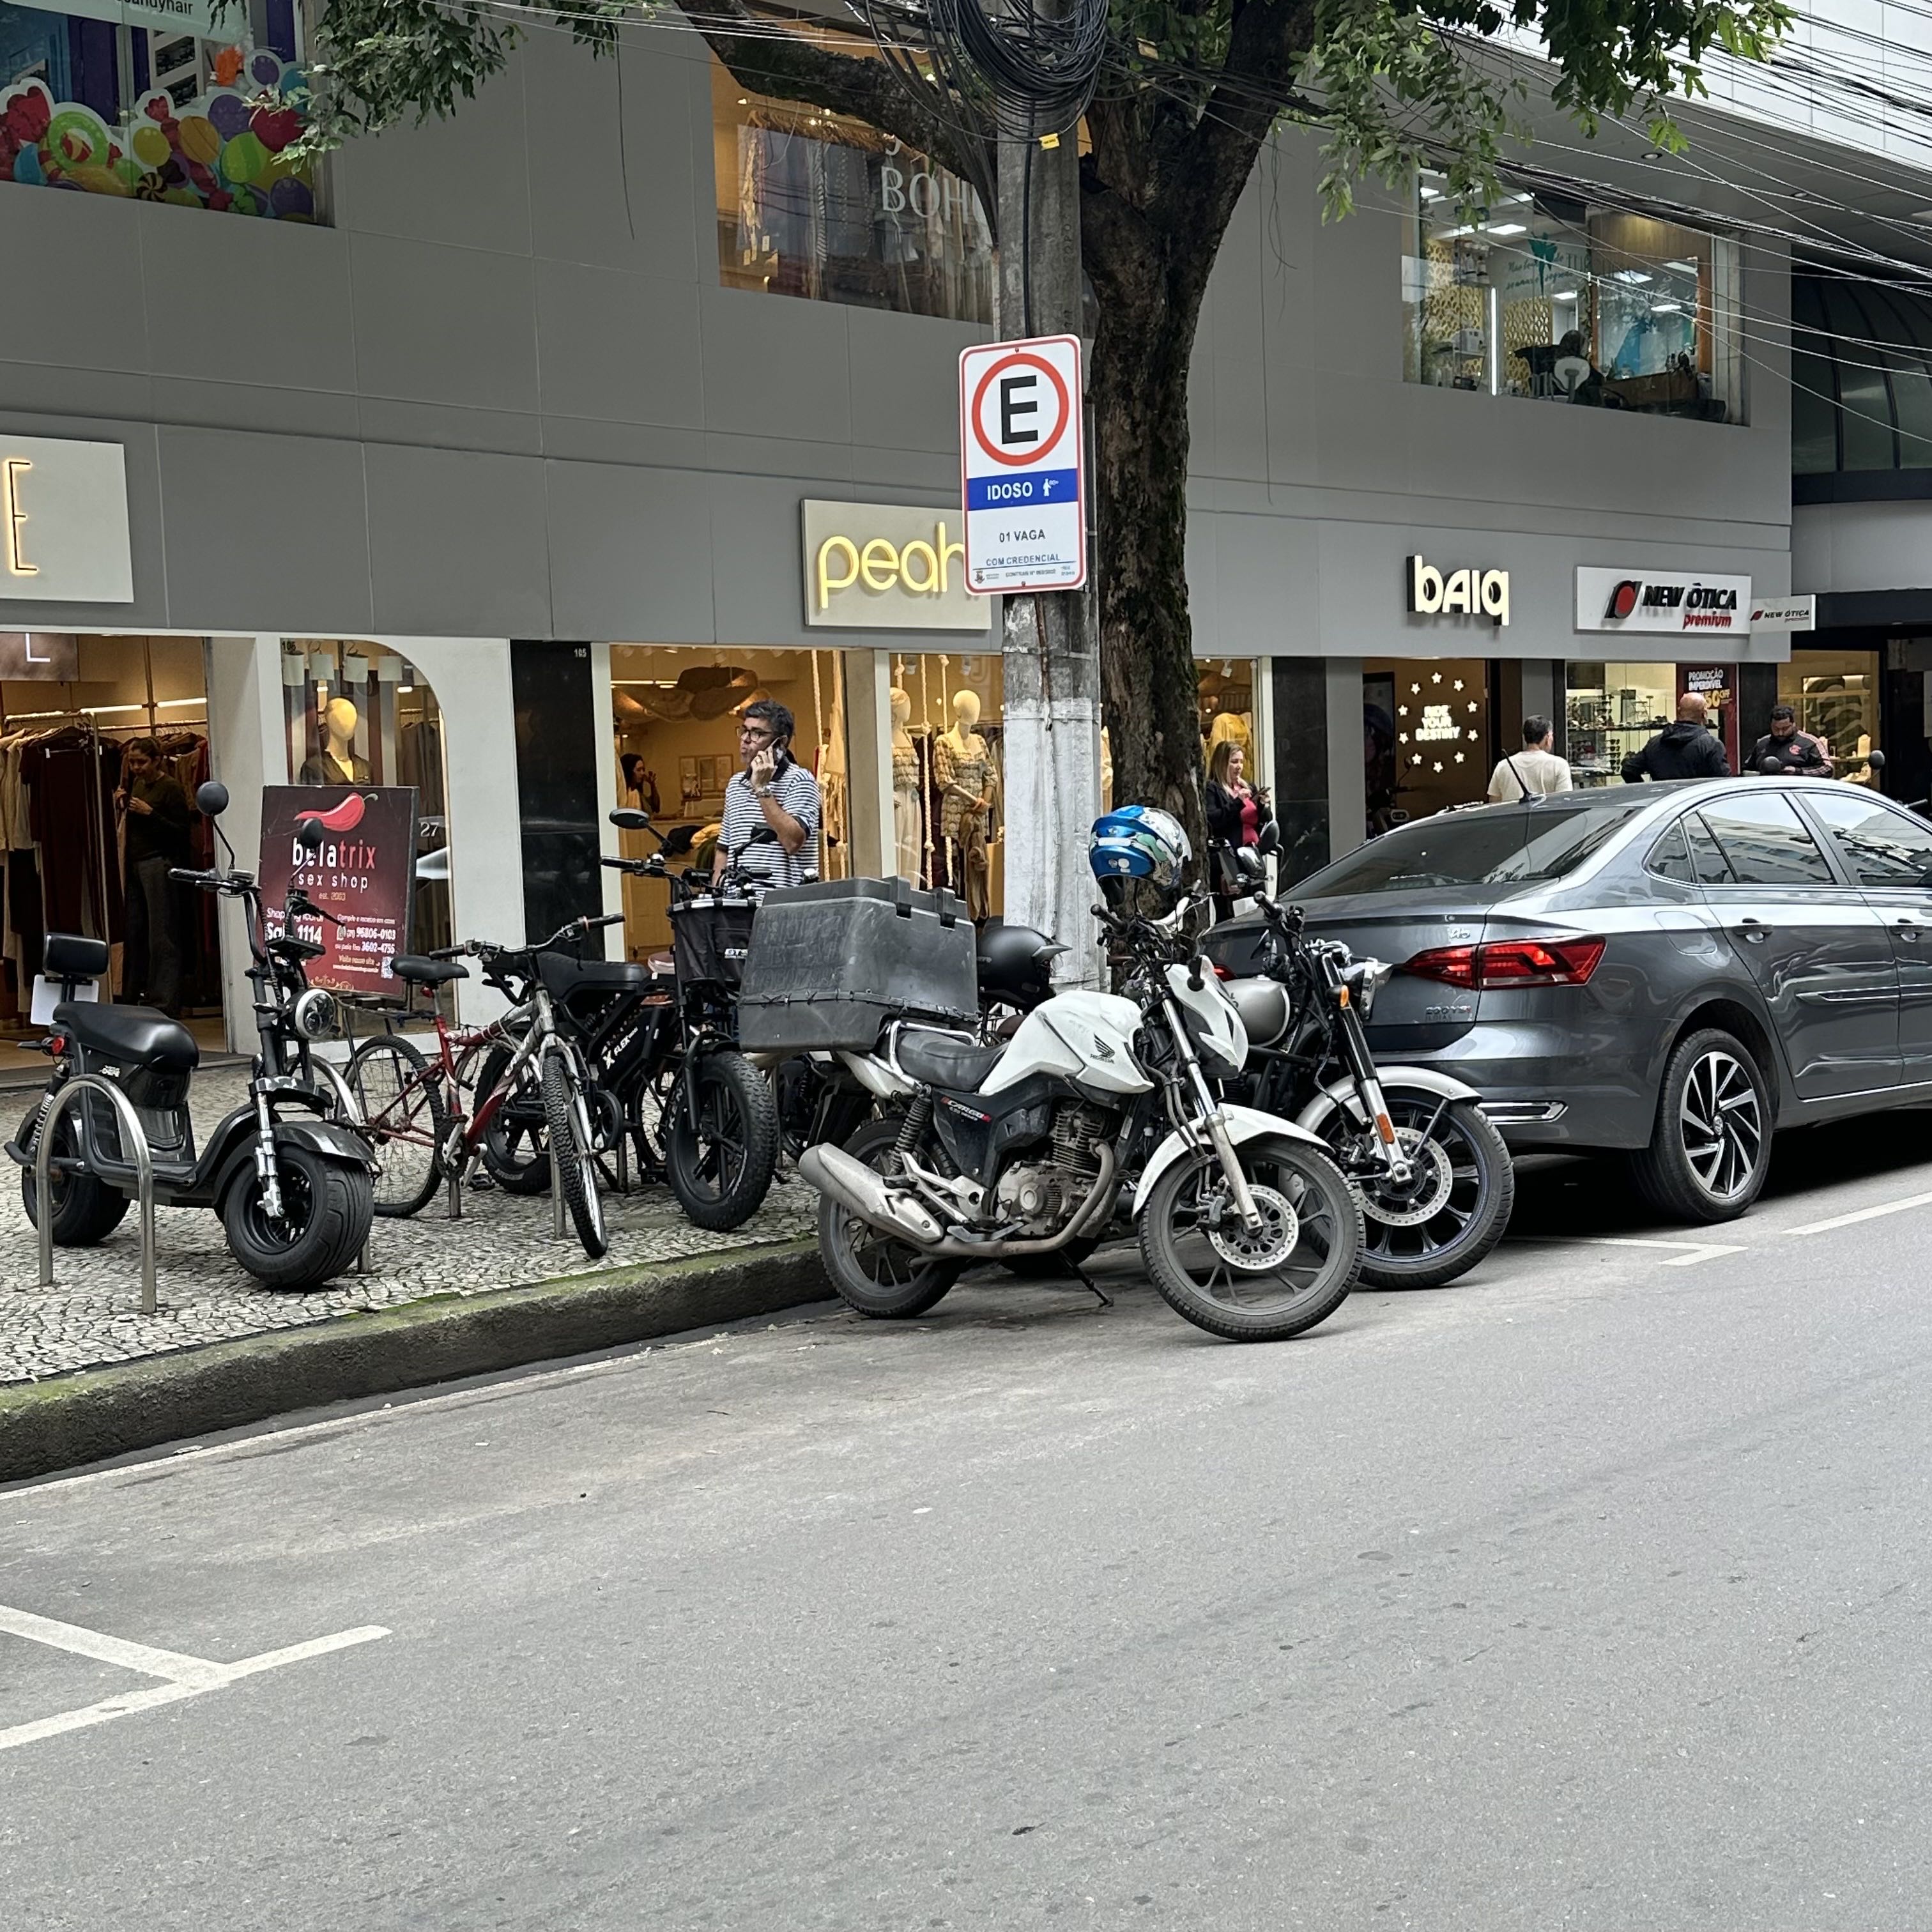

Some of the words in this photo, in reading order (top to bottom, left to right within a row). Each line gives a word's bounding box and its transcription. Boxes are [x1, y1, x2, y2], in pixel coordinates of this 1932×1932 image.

[1000, 374, 1038, 445] E
[987, 481, 1033, 500] IDOSO
[999, 532, 1010, 543] 01
[1014, 528, 1046, 541] VAGA
[986, 557, 1004, 566] COM
[1006, 553, 1061, 565] CREDENCIAL
[1643, 585, 1685, 607] NEW
[1682, 611, 1731, 630] premium
[298, 873, 323, 886] sex
[332, 871, 368, 894] shop
[297, 924, 322, 945] 1114
